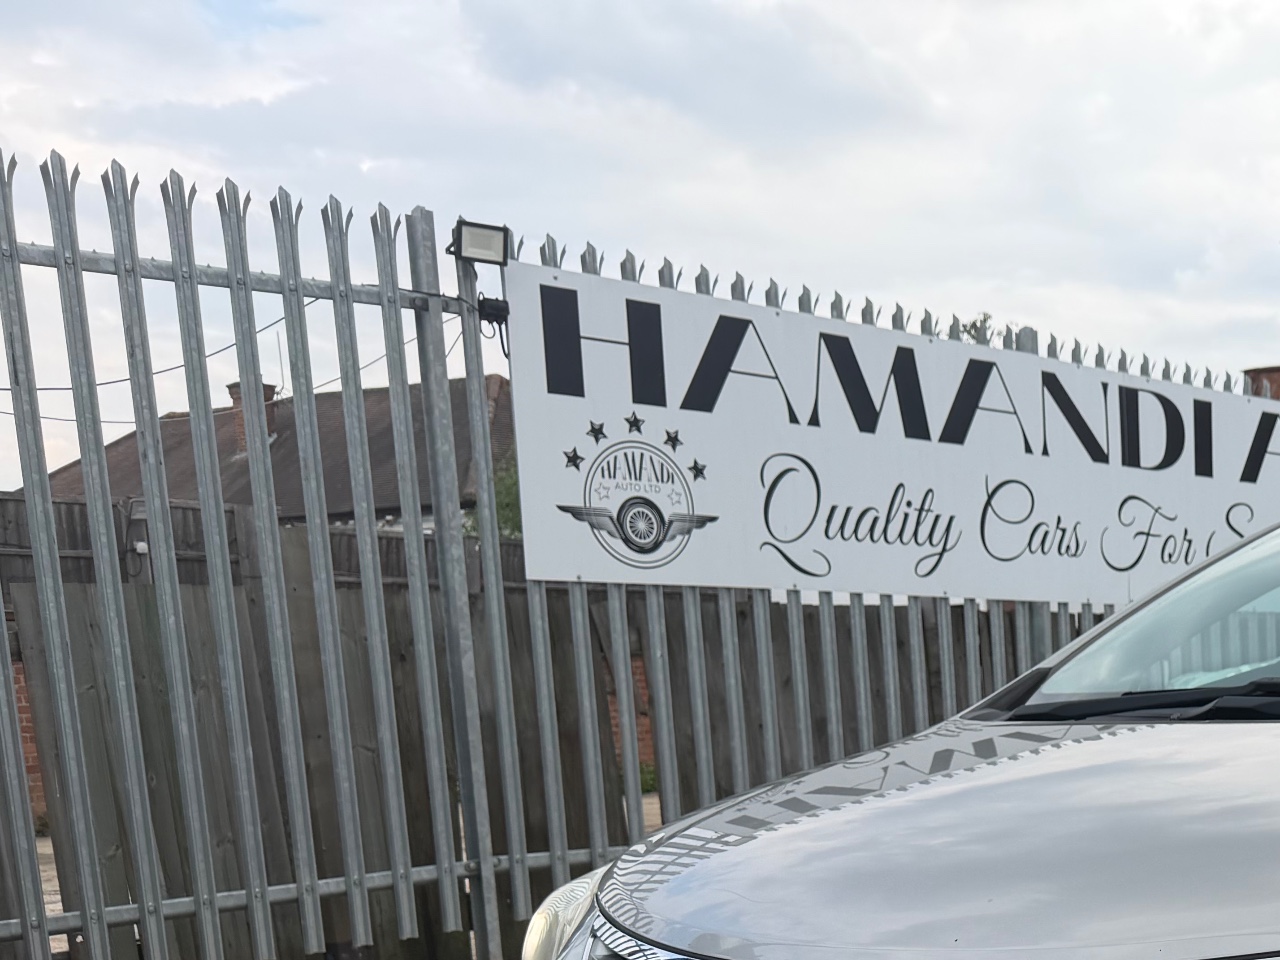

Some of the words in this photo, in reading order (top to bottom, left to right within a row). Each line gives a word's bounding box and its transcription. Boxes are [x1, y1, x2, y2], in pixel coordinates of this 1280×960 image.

[540, 284, 1213, 478] HAMANDI
[601, 451, 675, 486] HAMANDI
[615, 481, 642, 492] AUTO
[644, 484, 662, 494] LTD
[760, 452, 963, 578] Quality
[979, 474, 1087, 562] Cars
[1100, 495, 1196, 572] For
